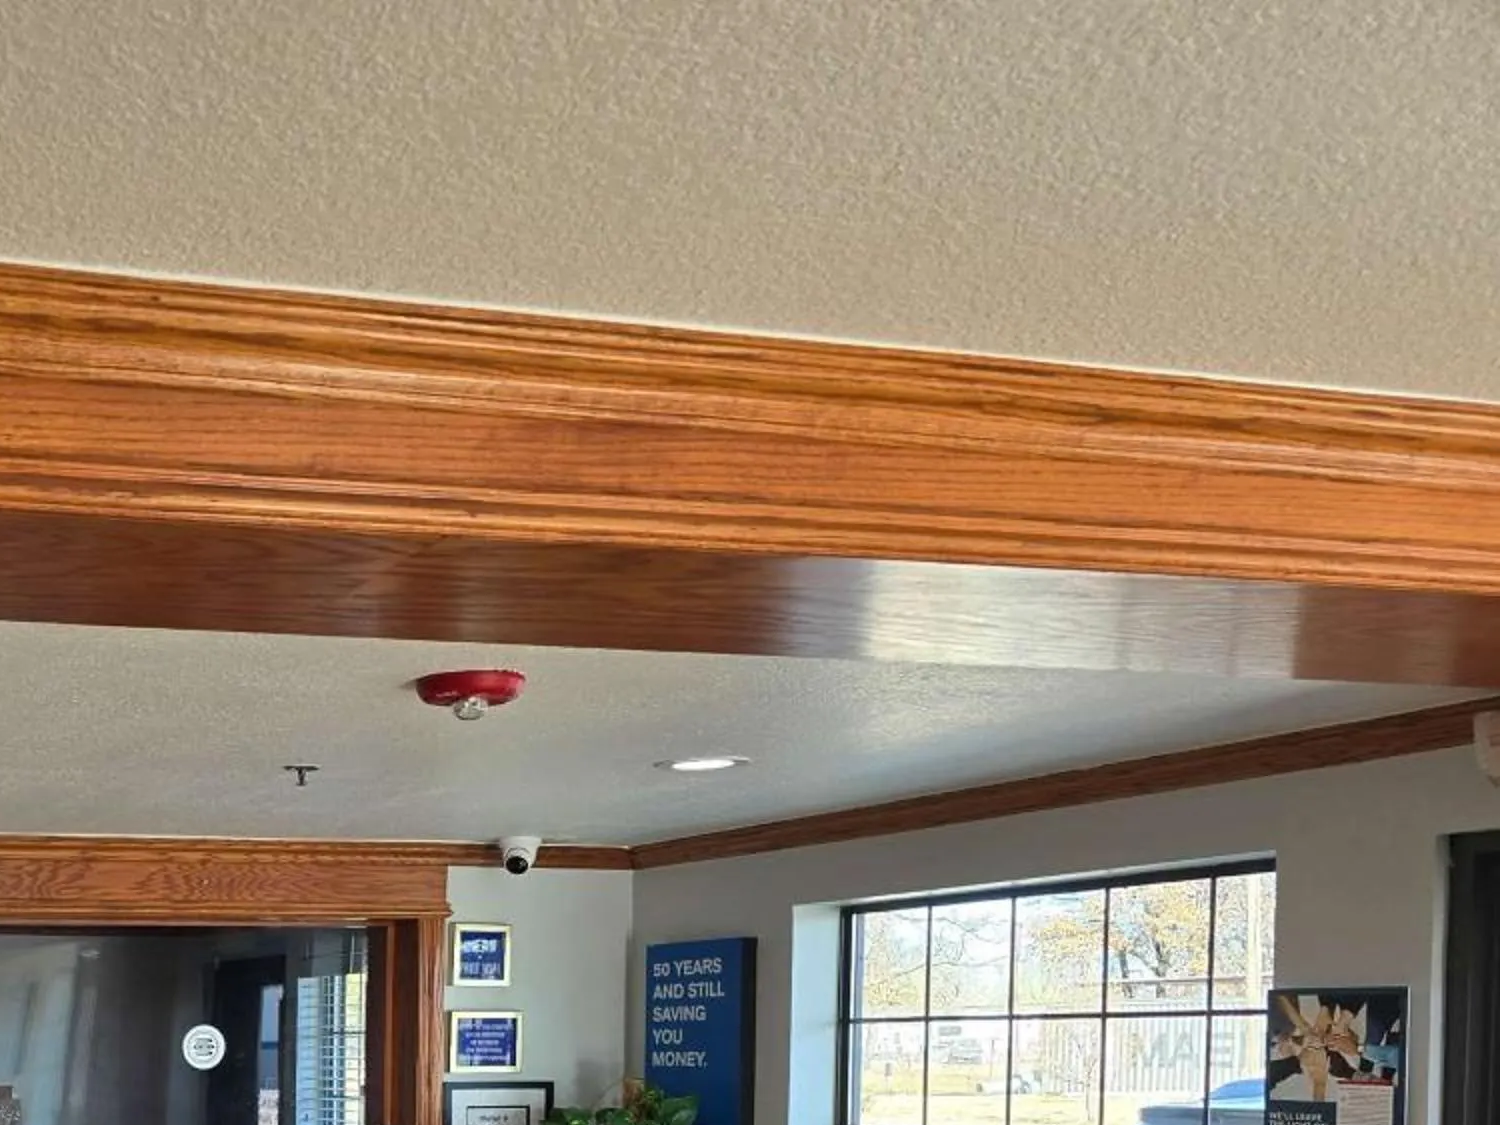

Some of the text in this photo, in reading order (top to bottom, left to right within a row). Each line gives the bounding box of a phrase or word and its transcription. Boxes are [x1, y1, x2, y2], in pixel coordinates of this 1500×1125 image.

[653, 957, 722, 977] 50 YEARS
[653, 980, 725, 999] AND STILL
[652, 1005, 707, 1022] SAVING
[652, 1028, 683, 1045] YOU
